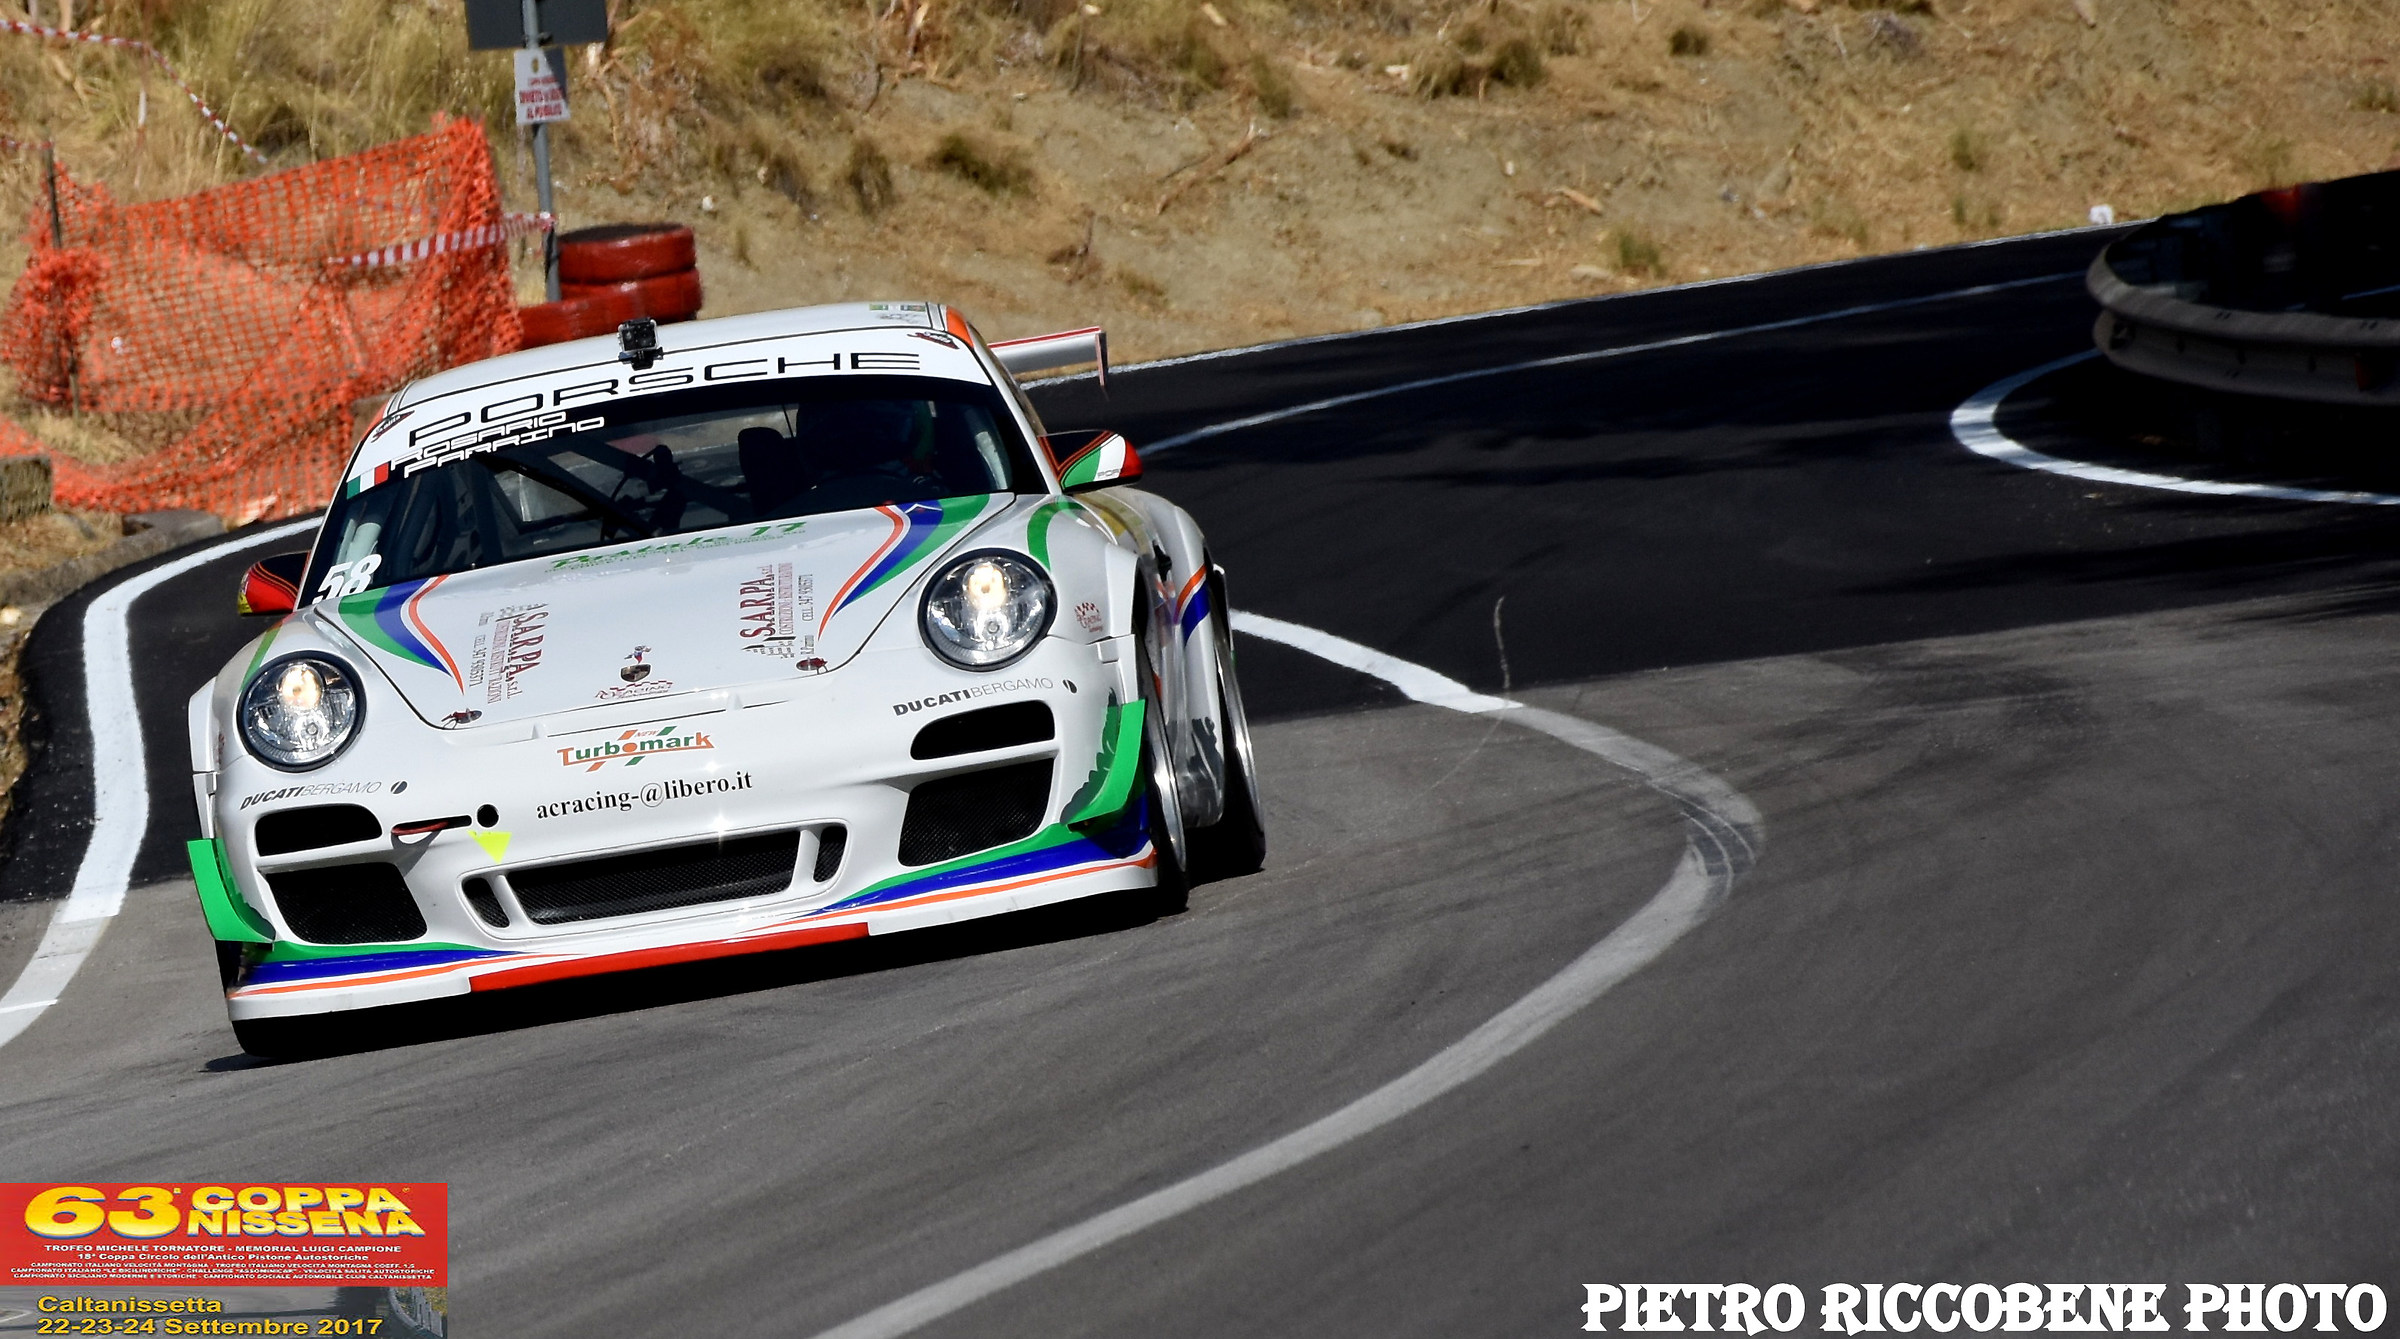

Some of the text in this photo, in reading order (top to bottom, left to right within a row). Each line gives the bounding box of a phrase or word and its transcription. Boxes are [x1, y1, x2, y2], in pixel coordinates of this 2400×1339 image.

[408, 352, 921, 449] PORSCHE
[390, 411, 567, 471] ROSARIO
[403, 416, 605, 479] PARRINO
[312, 553, 383, 605] 58
[556, 731, 715, 766] Turbomark
[536, 771, 753, 821] acracing-@libero.it
